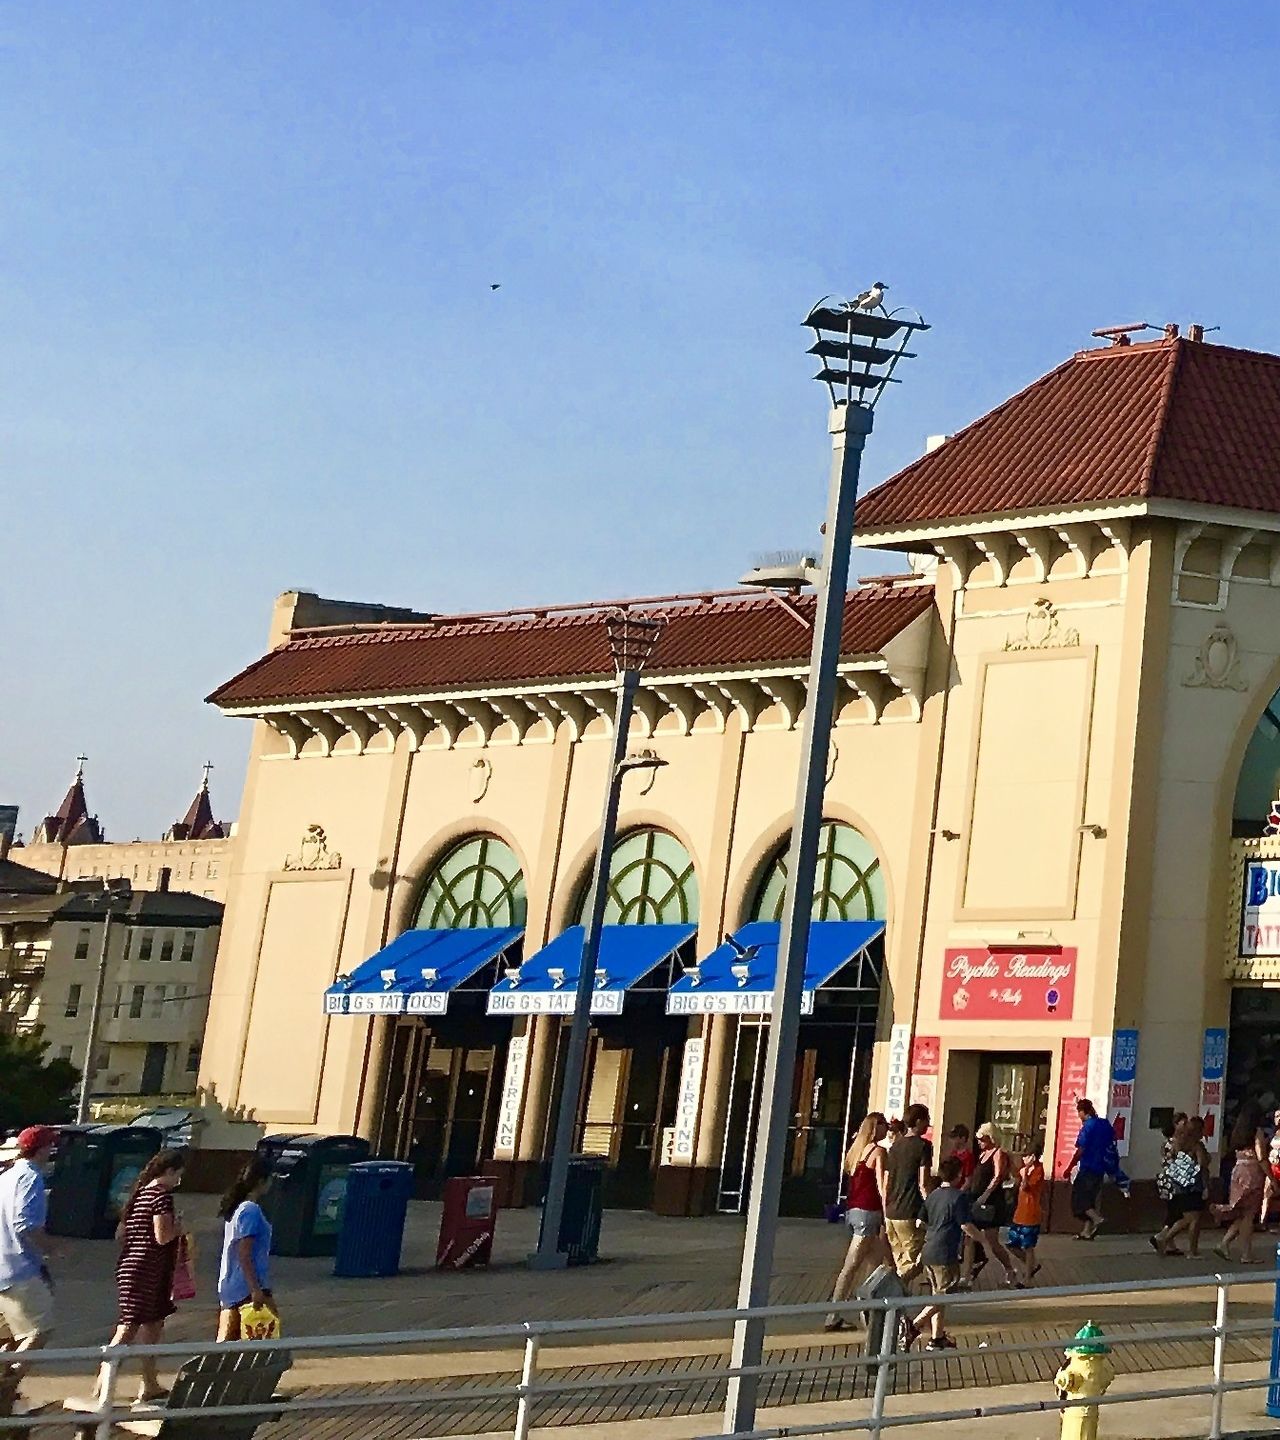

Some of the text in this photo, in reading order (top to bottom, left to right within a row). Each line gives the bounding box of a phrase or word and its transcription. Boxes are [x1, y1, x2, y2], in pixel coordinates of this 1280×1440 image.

[947, 954, 1072, 985] Psychic Readings
[329, 995, 350, 1010] BIG
[379, 993, 442, 1009] TATOOS
[492, 994, 516, 1010] BIG
[547, 993, 616, 1009] TATOS
[673, 995, 699, 1010] BIG
[889, 1029, 906, 1109] TATTOOS
[501, 1053, 523, 1147] PIERCING
[677, 1055, 699, 1153] PIERCING
